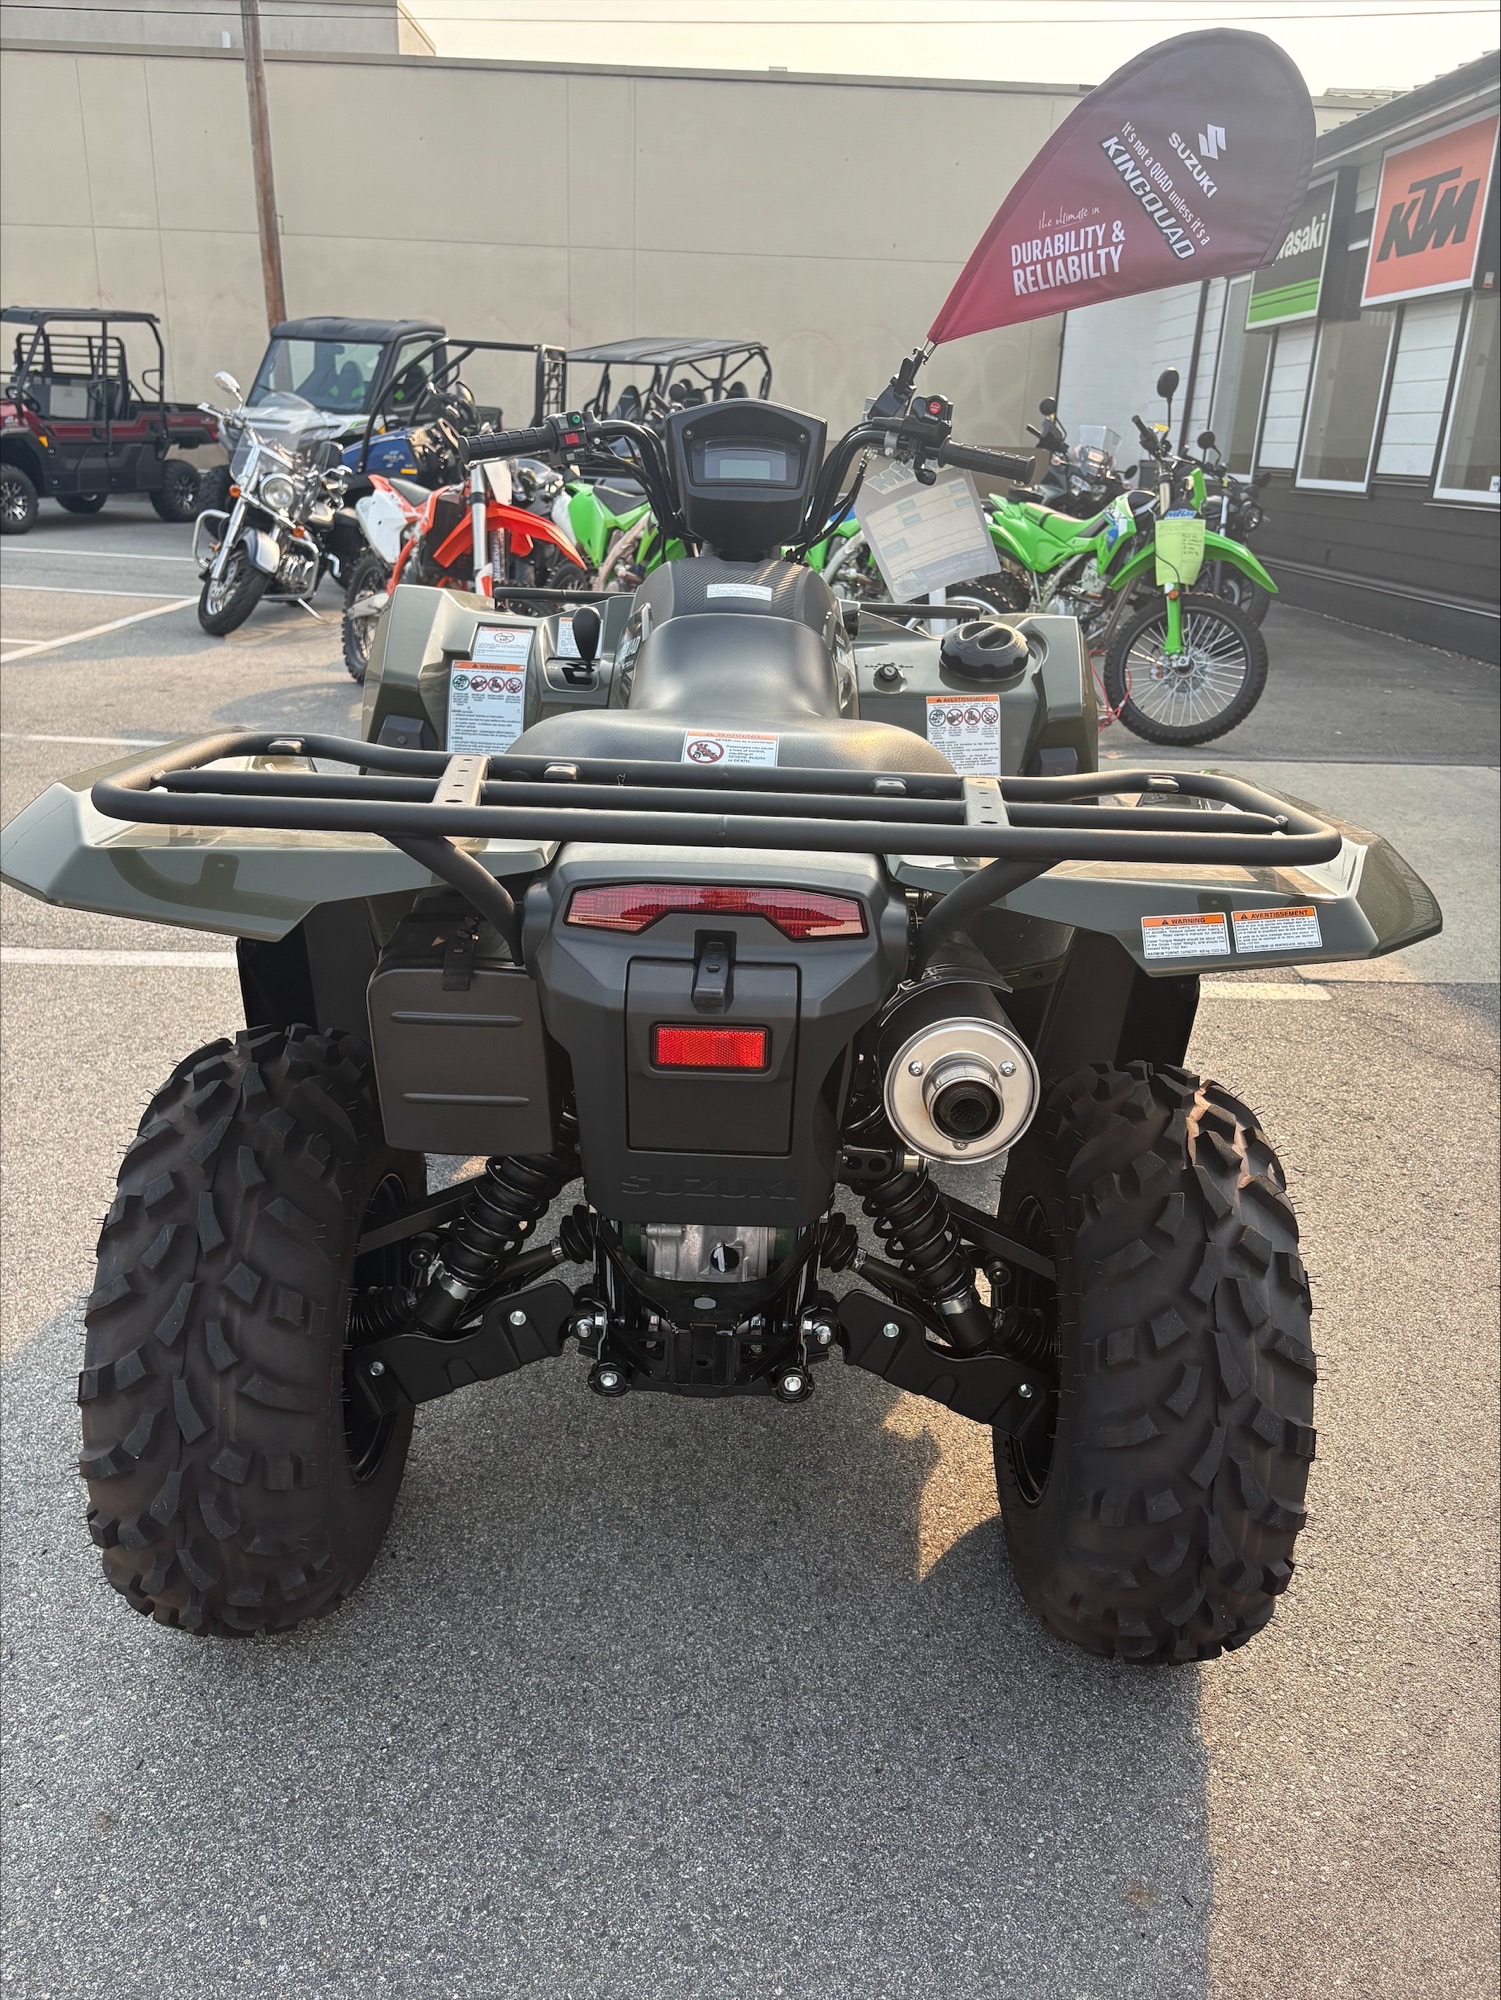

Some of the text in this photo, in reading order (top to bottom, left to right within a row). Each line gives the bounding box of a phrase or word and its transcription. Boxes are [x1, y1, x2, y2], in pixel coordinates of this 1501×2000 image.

[1121, 121, 1210, 246] It's not a QUAD unless it's a
[1169, 132, 1218, 198] SUZUKI
[1056, 206, 1089, 225] ultimate
[1101, 136, 1196, 260] KINGQUAD
[1376, 166, 1481, 263] KTM
[1011, 220, 1126, 267] DURABILITY &
[1275, 213, 1326, 261] asaki
[1013, 244, 1124, 296] RELIABILTY
[1171, 917, 1206, 925] WARNING
[1251, 910, 1308, 919] AVERTISSEMENT
[622, 1175, 798, 1200] SUZUKI
